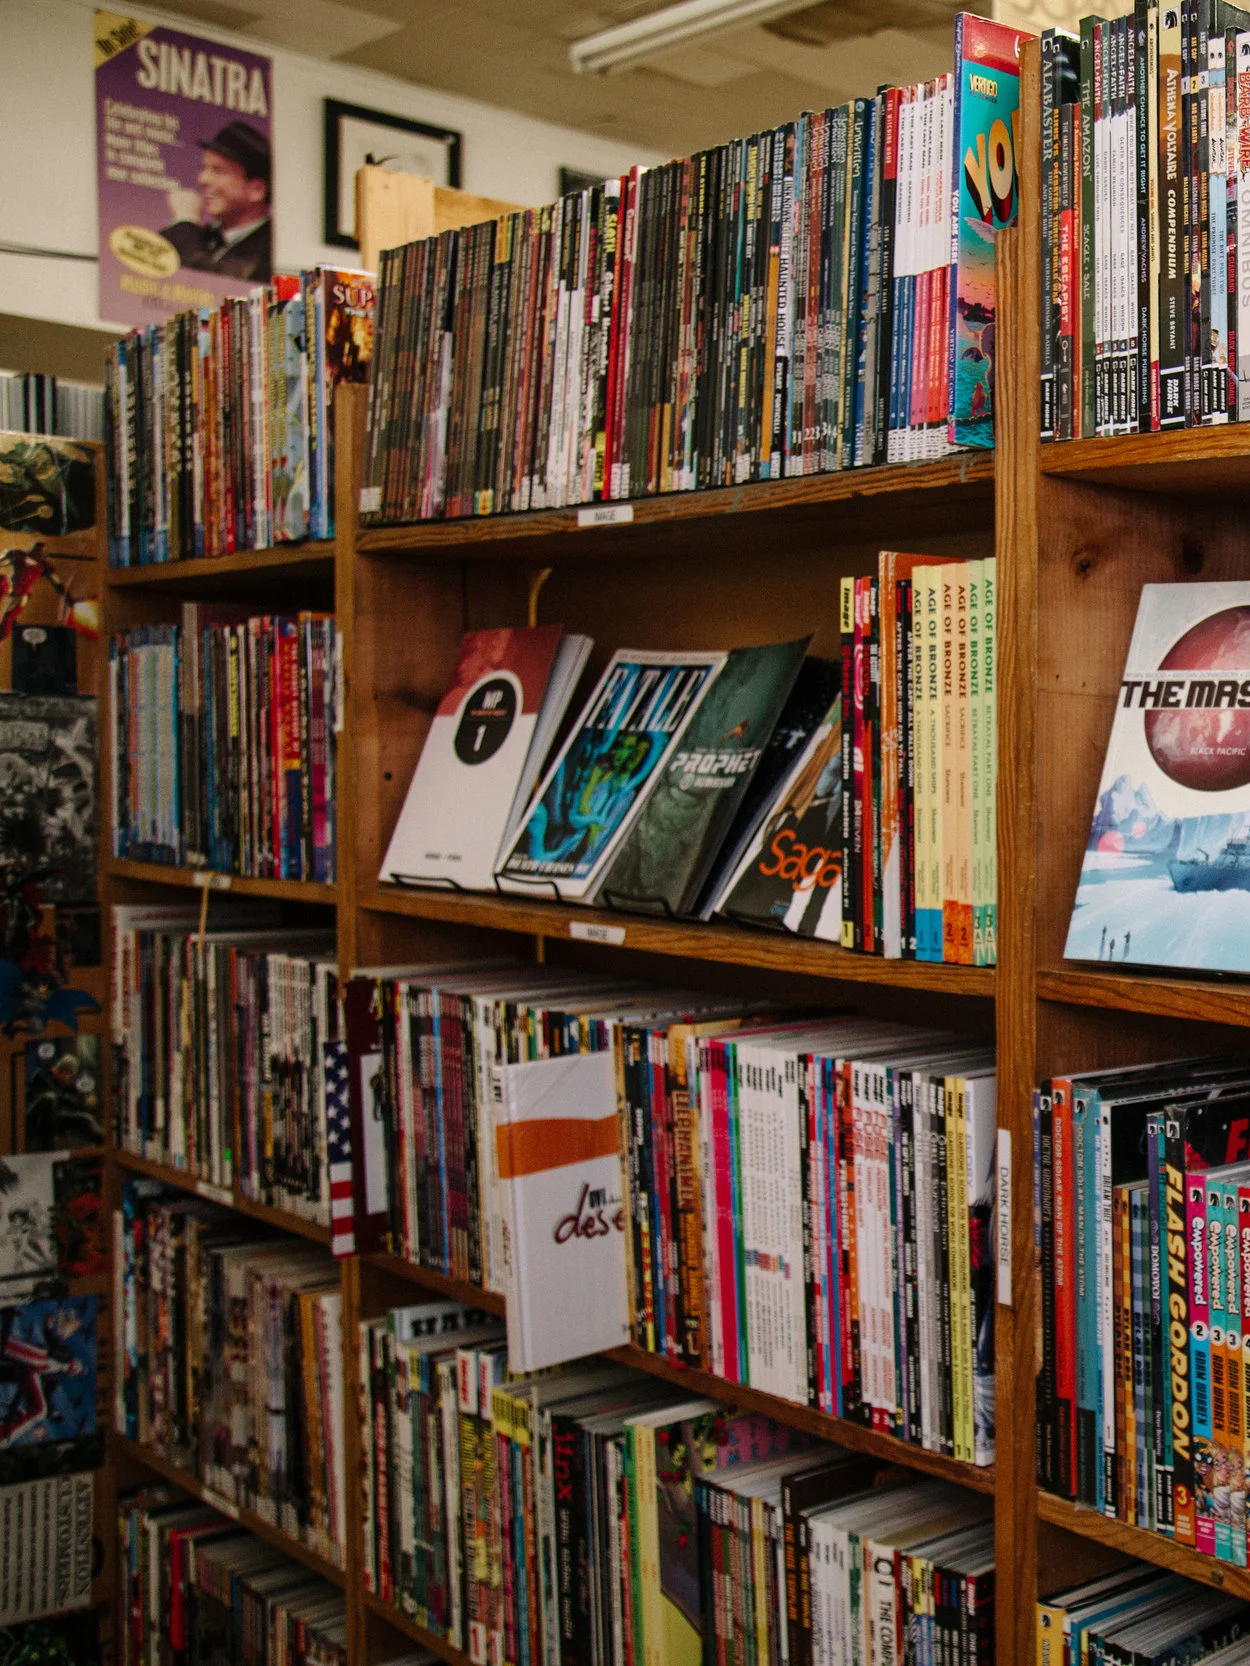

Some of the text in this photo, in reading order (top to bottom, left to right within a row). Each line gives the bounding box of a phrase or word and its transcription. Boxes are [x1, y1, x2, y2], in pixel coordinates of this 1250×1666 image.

[136, 37, 267, 118] SINATRA
[969, 73, 998, 98] VERTIGO
[1042, 60, 1053, 161] ALABASTER
[1082, 79, 1091, 177] THE AMAZON
[952, 189, 960, 217] YOU
[1163, 68, 1178, 280] ATHENA VOLTAIRE COMPENDIUM
[951, 240, 959, 265] HERE
[1061, 224, 1069, 323] THE ESCAPIST
[943, 583, 952, 698] AGE OF BRONZE
[984, 578, 993, 694] AGE OF BRONZE
[1120, 680, 1185, 709] THE
[474, 725, 487, 752] 1
[670, 749, 760, 774] PROPHET
[1190, 746, 1247, 757] BLACK PACIFIC
[759, 831, 842, 892] Saga
[999, 1167, 1009, 1267] DARK HORSE
[1149, 1243, 1160, 1300] DOMOVOI
[1191, 1216, 1207, 1307] empowered
[1165, 1161, 1190, 1461] FLASH GORDON
[1195, 1324, 1204, 1337] 2
[1195, 1349, 1208, 1427] ADAM WARREN
[1177, 1485, 1188, 1505] 3
